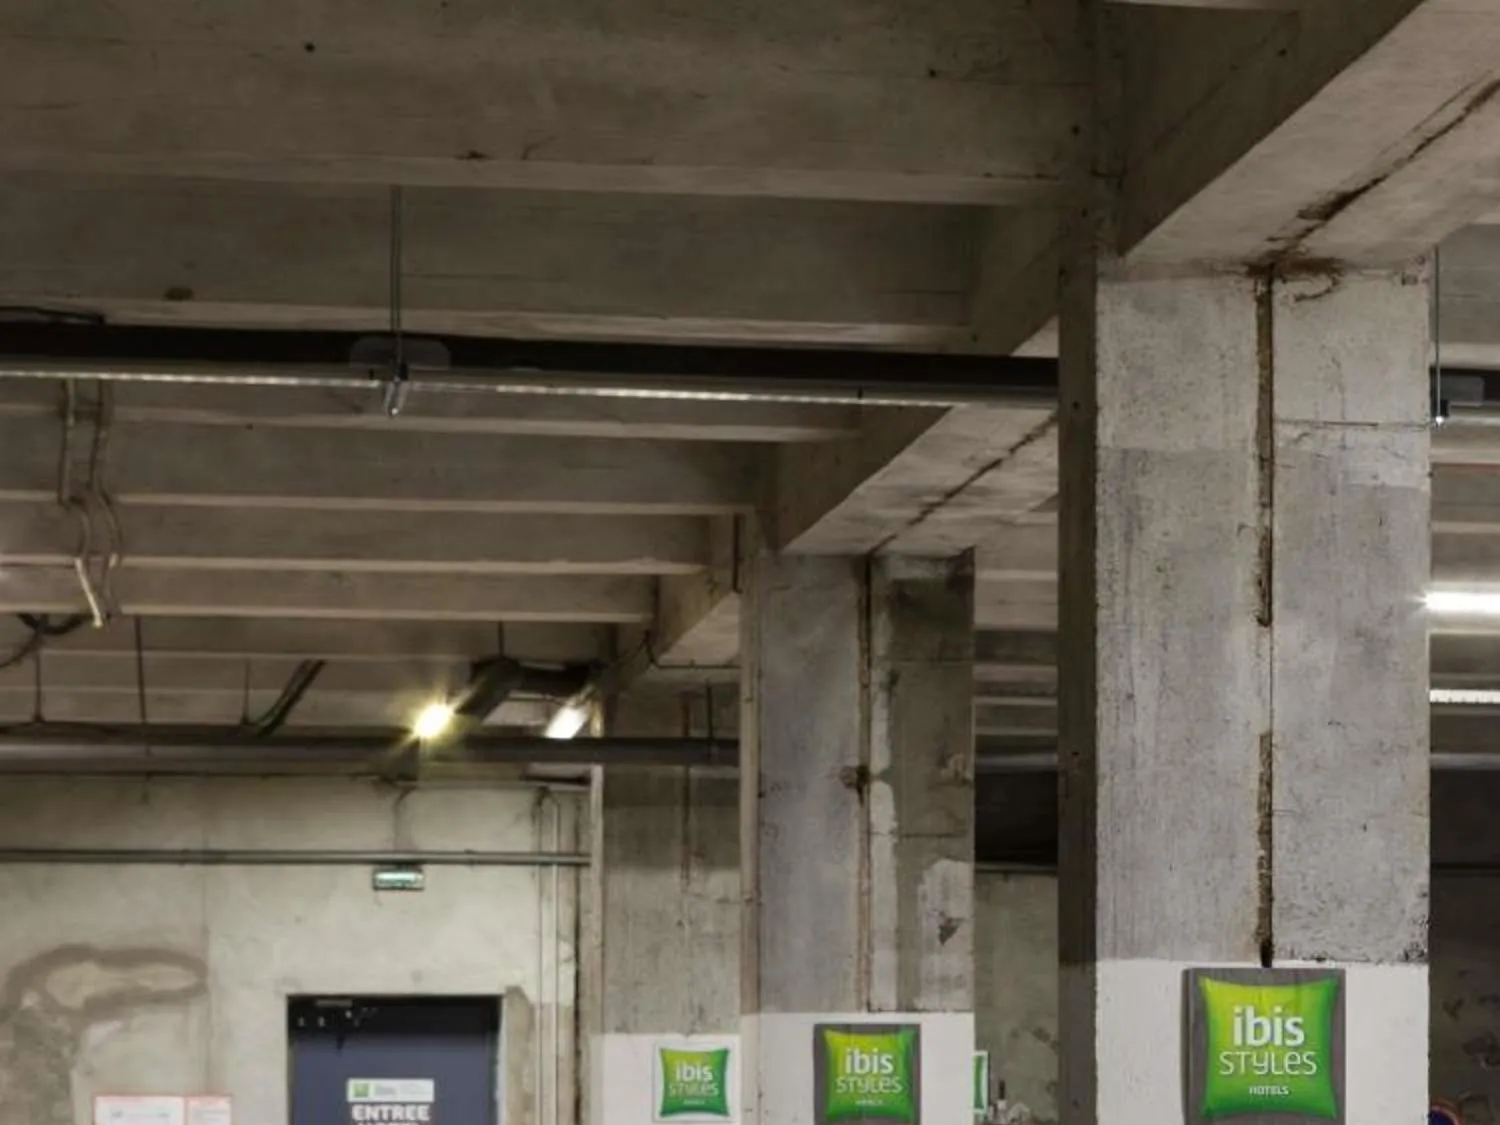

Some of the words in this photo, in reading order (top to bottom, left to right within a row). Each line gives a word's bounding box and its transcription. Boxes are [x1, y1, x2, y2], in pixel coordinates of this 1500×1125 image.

[1233, 1005, 1306, 1047] ibis
[845, 1047, 895, 1074] ibis
[351, 1104, 431, 1121] ENTREE
